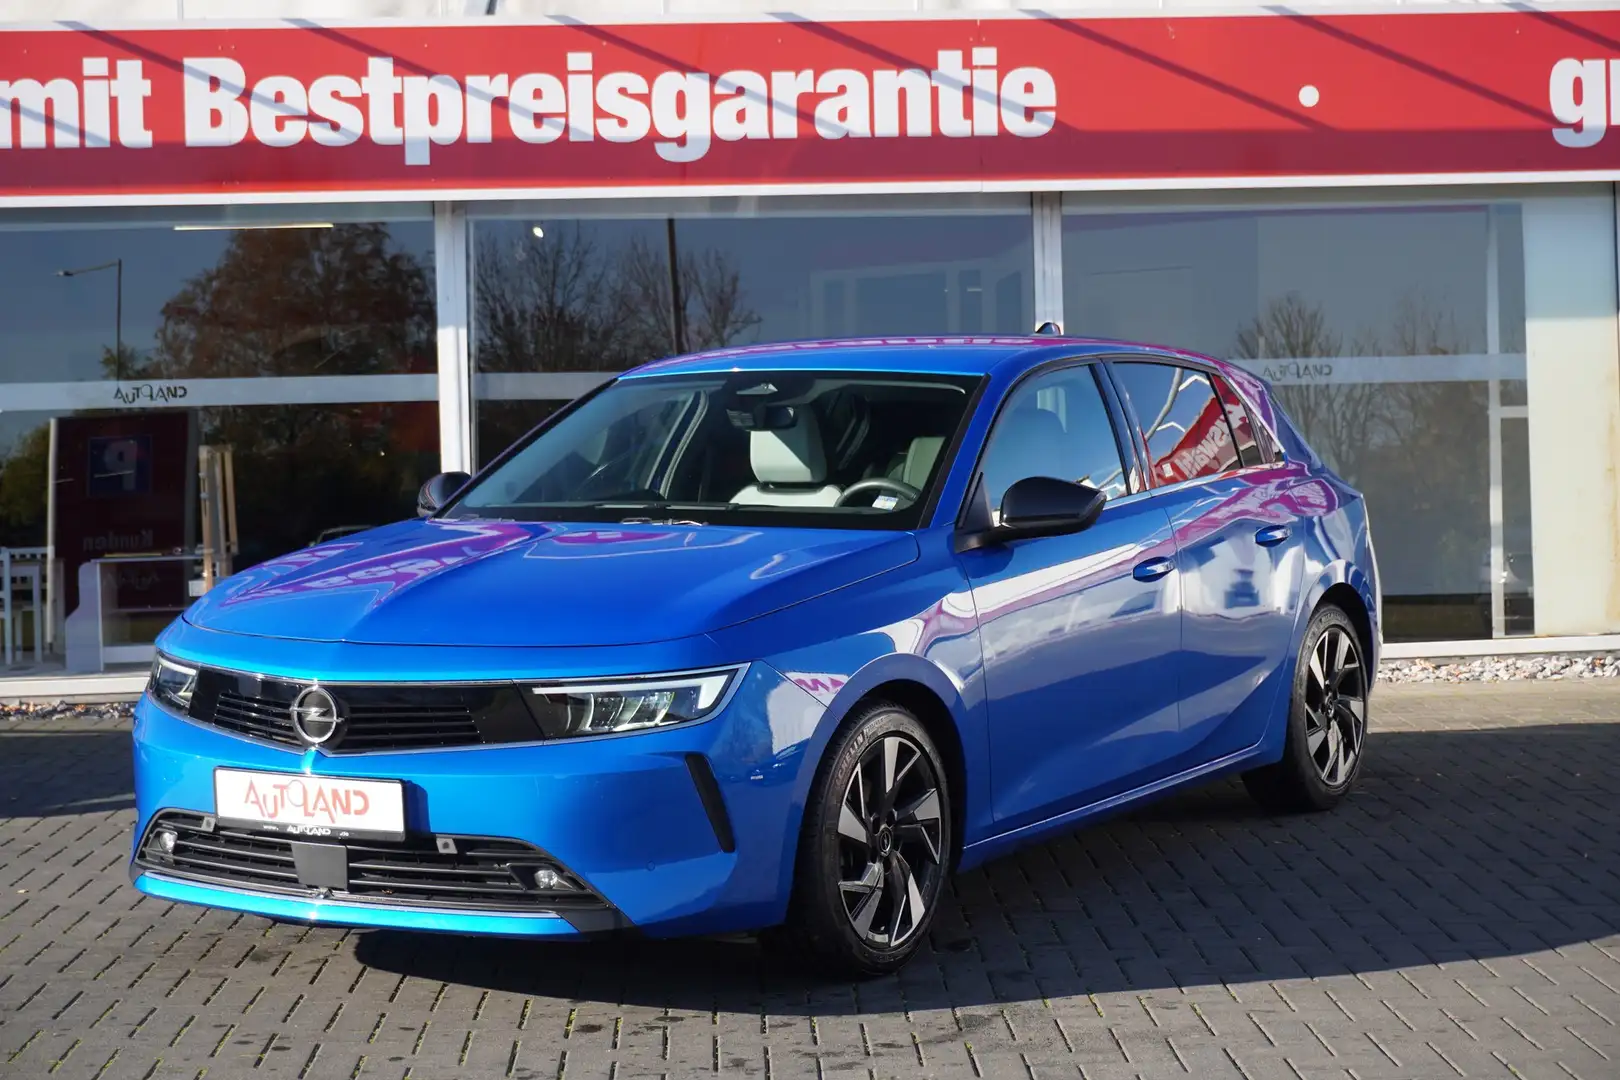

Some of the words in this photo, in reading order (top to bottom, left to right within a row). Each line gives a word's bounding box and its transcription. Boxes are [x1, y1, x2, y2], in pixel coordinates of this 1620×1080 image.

[0, 57, 153, 148] mit
[183, 47, 1057, 165] Bestpreisgarantie
[113, 383, 188, 405] AUTOLAND
[244, 779, 370, 825] AUTOLAND
[286, 824, 332, 836] AUTOLAND
